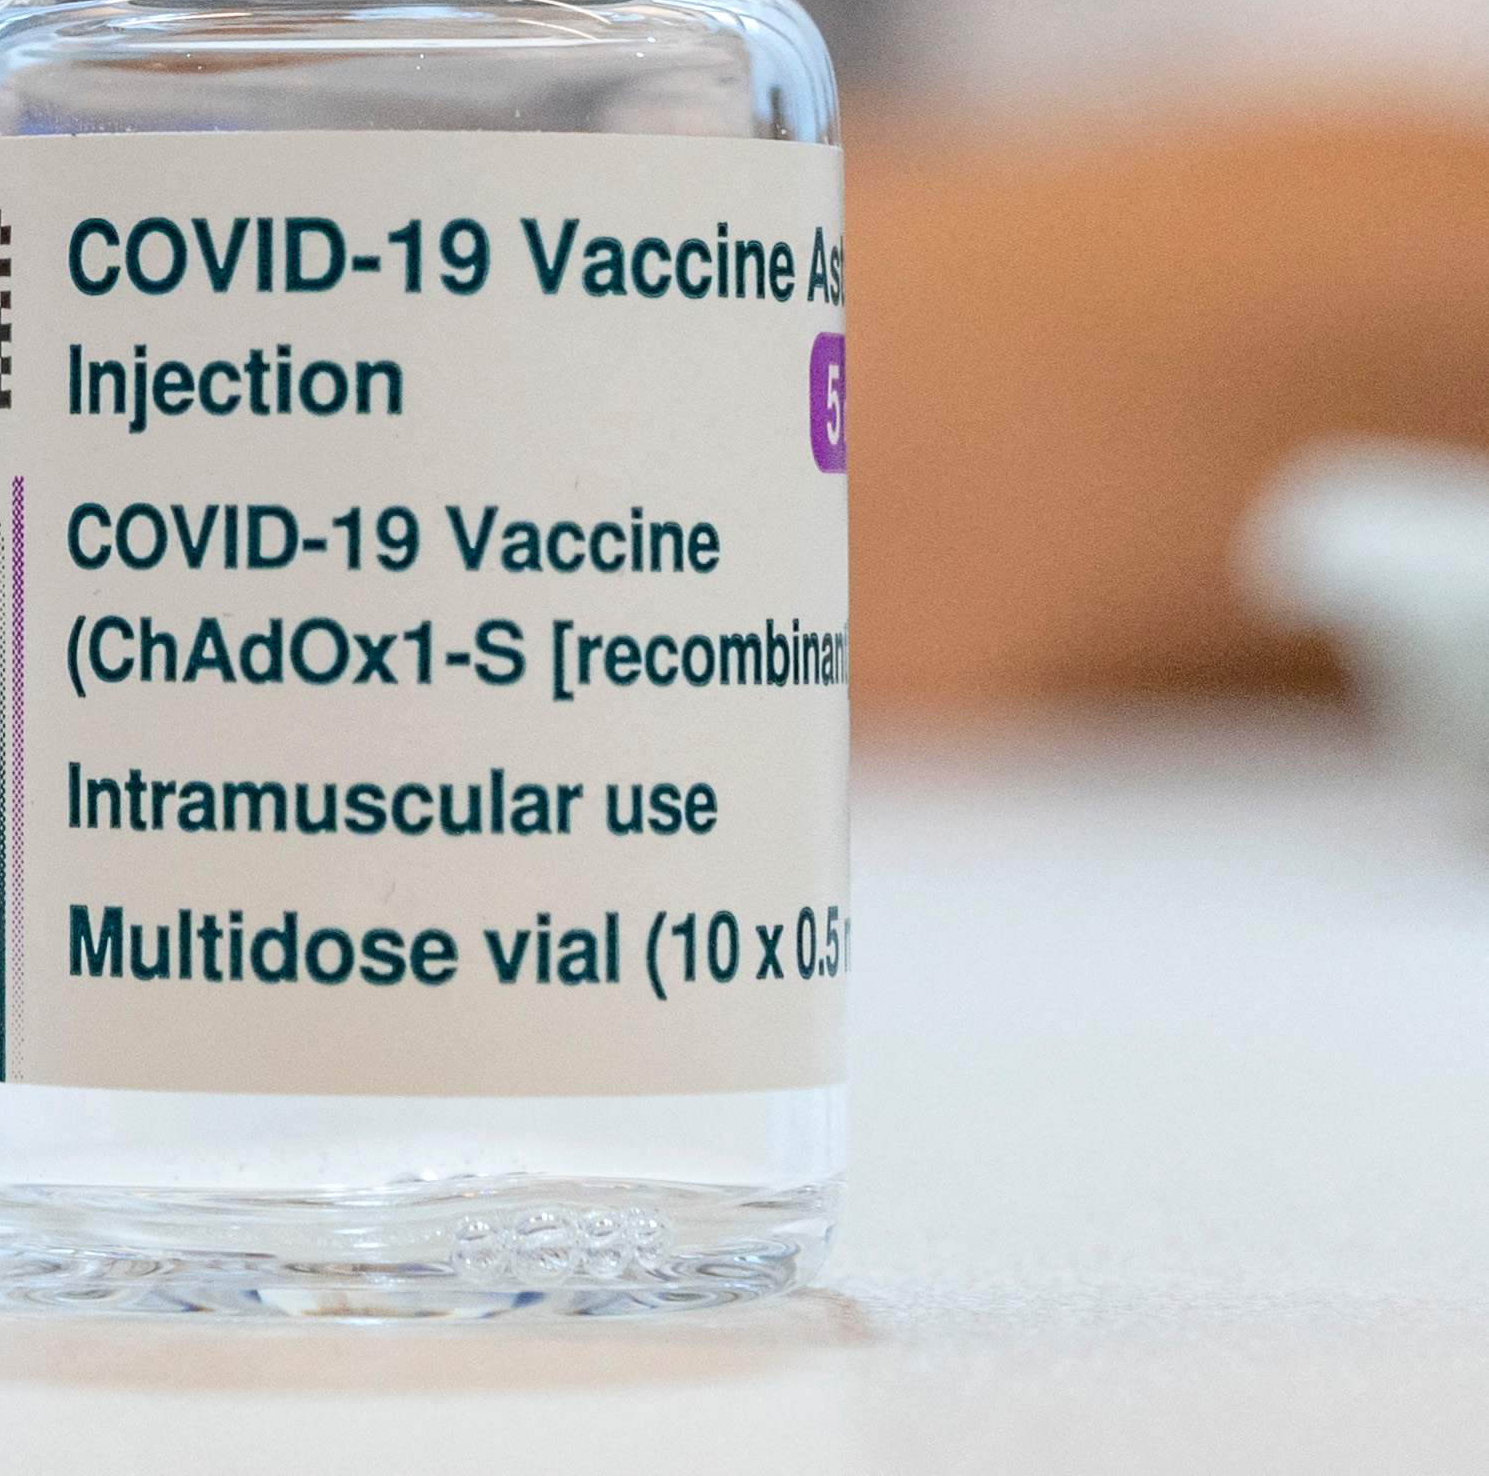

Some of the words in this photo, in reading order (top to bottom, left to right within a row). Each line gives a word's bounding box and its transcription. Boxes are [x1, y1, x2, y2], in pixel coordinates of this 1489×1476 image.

[68, 216, 491, 297] COVID-19
[519, 217, 796, 303] Vaccine
[68, 343, 404, 435] Injection
[67, 501, 421, 573] COVID-19
[444, 504, 721, 575] Vaccine
[67, 614, 527, 699] (ChAdOx1-S
[68, 761, 584, 837] Intramuscular
[605, 782, 719, 837] use
[69, 903, 459, 987] Multidose
[483, 911, 620, 987] vial
[645, 909, 740, 1002] (10
[755, 923, 785, 981] x
[795, 905, 840, 981] 0.5
